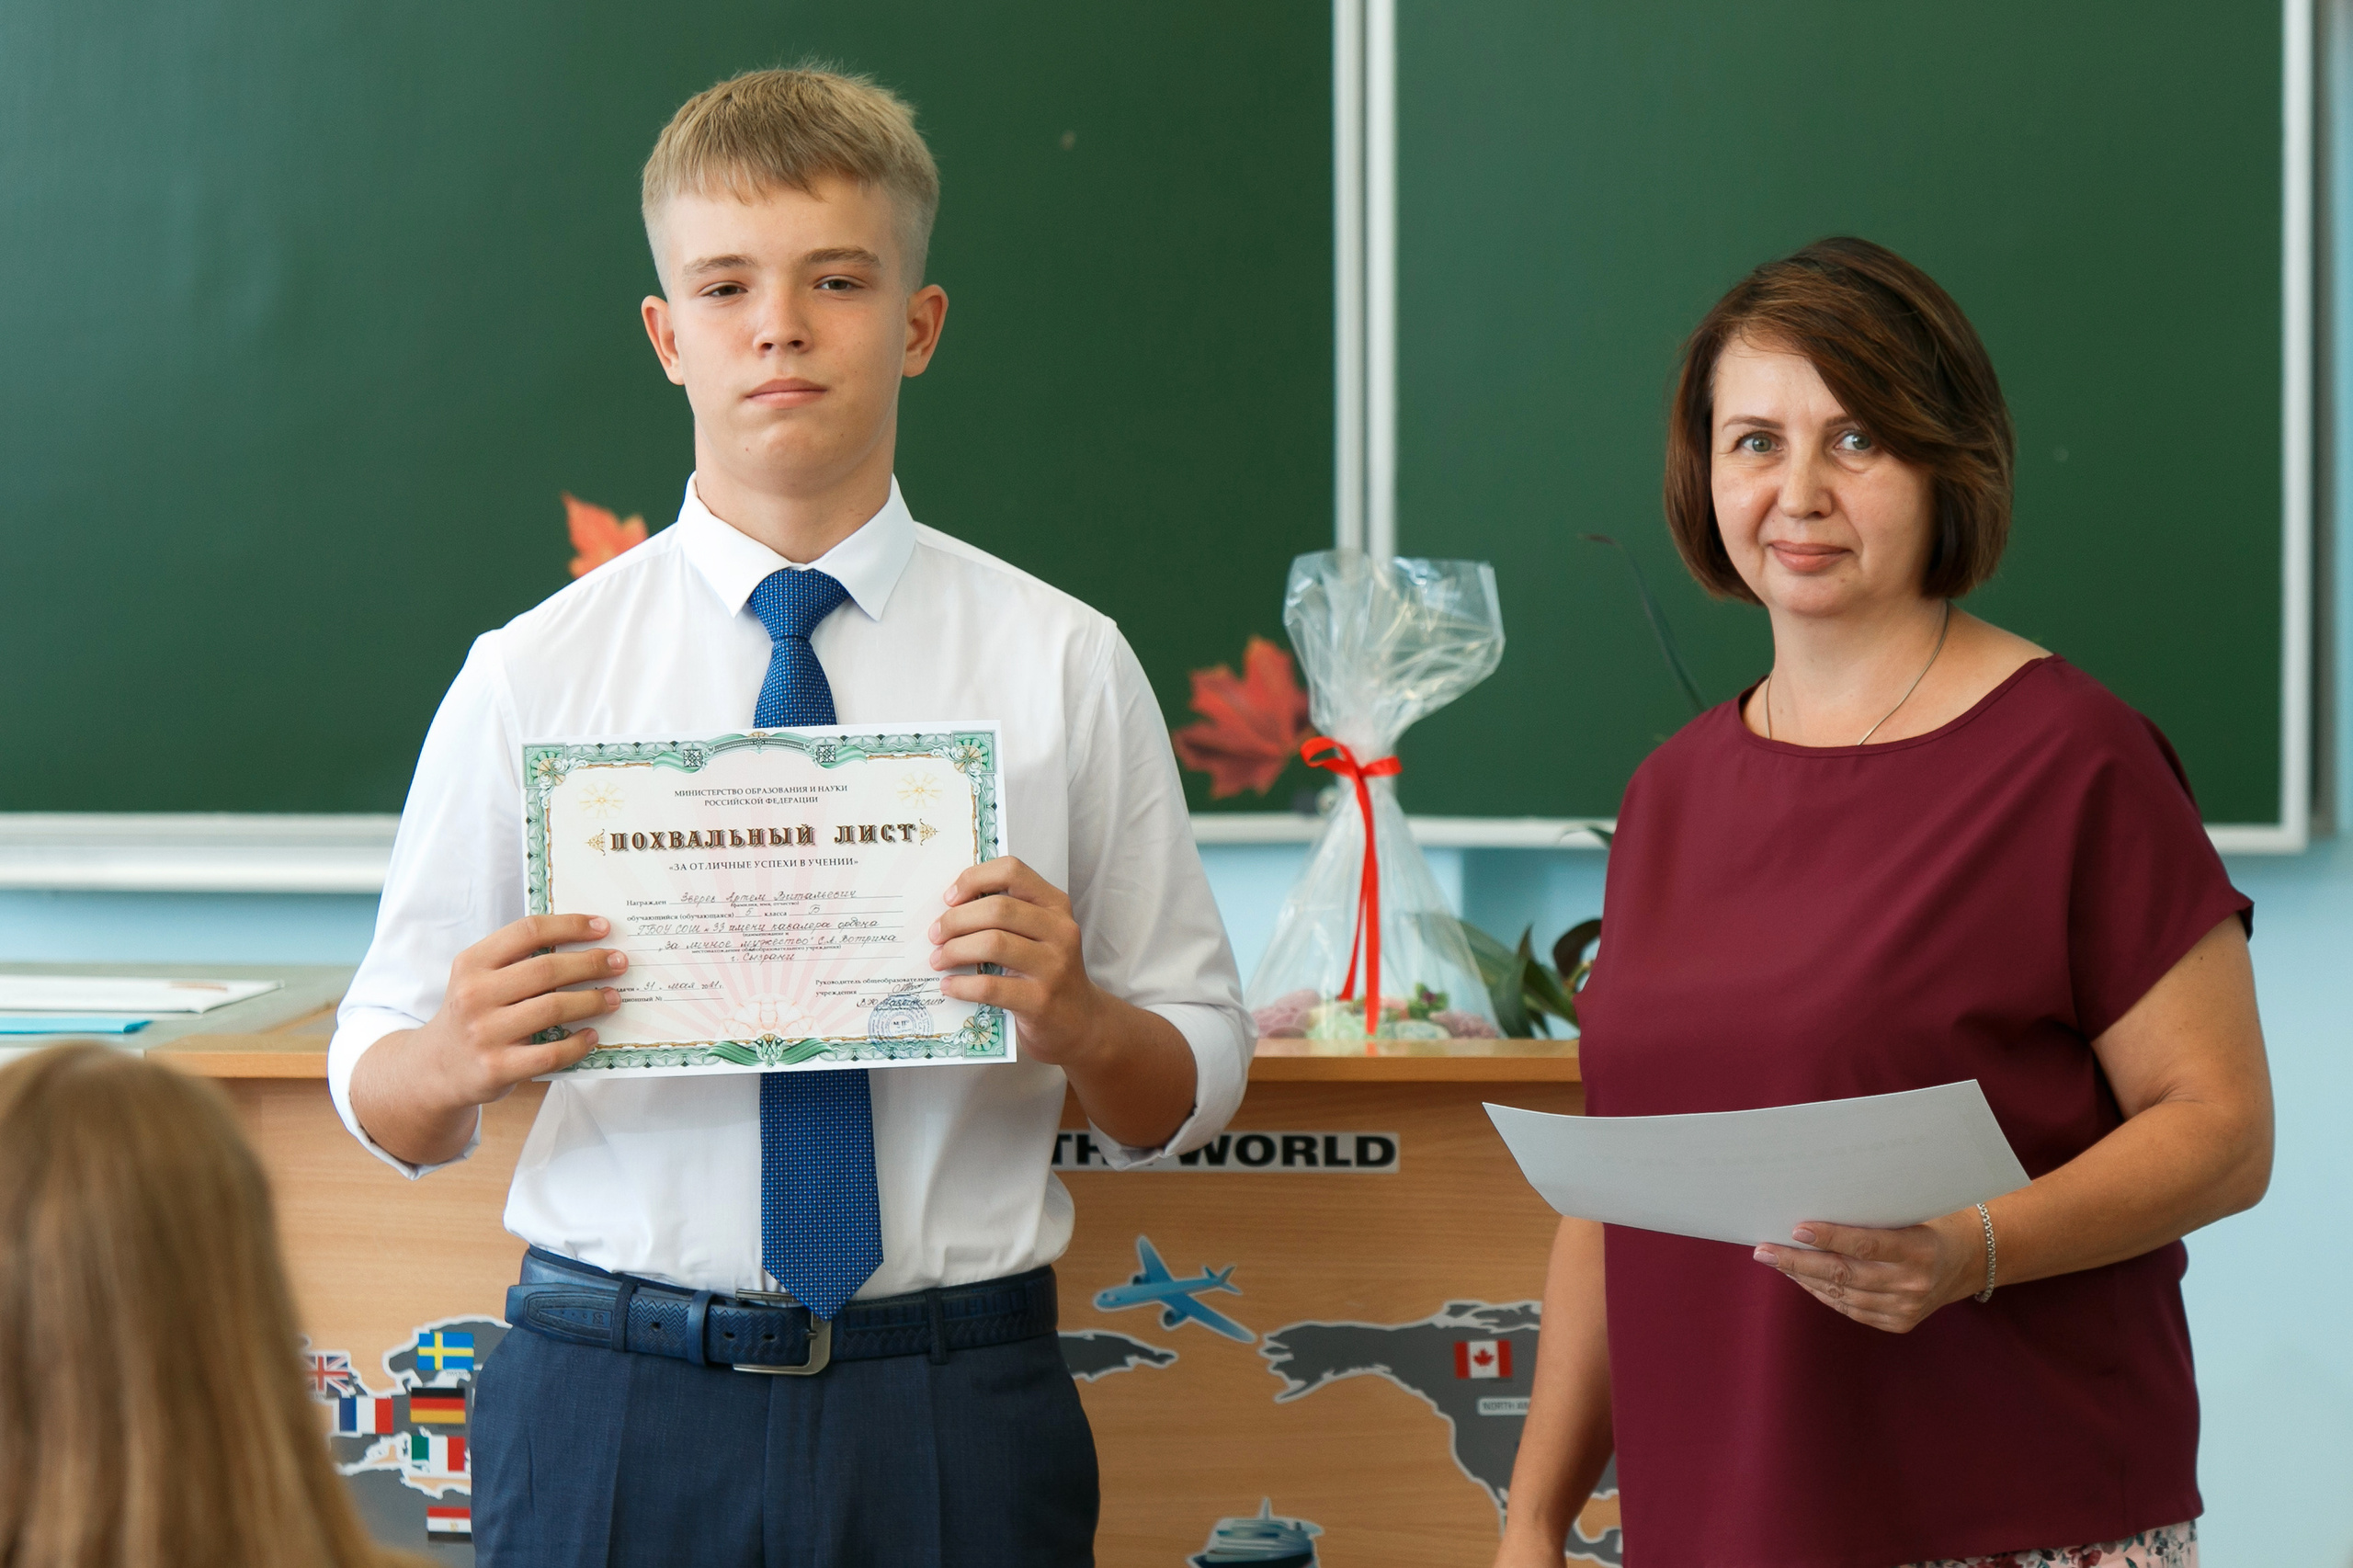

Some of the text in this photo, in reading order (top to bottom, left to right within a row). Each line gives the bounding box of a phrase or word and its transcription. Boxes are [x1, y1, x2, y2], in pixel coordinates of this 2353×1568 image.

[674, 788, 744, 797] МИНИСТЕРСТВО
[745, 786, 808, 795] ОБРАЗОВАНИЯ
[817, 785, 847, 793] НАУКИ
[704, 796, 818, 806] РОССИЙСКОЙ ФЕДЕРАЦИИ
[609, 824, 917, 852] ПОХВАЛЬНЫЙ ЛИСТ
[669, 862, 687, 871] «ЗА
[689, 860, 752, 870] ОТЛИЧНЫЕ
[754, 859, 797, 869] УСПЕХИ
[808, 858, 858, 867] УЧЕНИИ»
[745, 907, 754, 916] 5
[627, 912, 734, 923] обучающийся (обучающаяся)
[862, 976, 940, 985] общеобразовательного
[1178, 1133, 1397, 1167] WORLD
